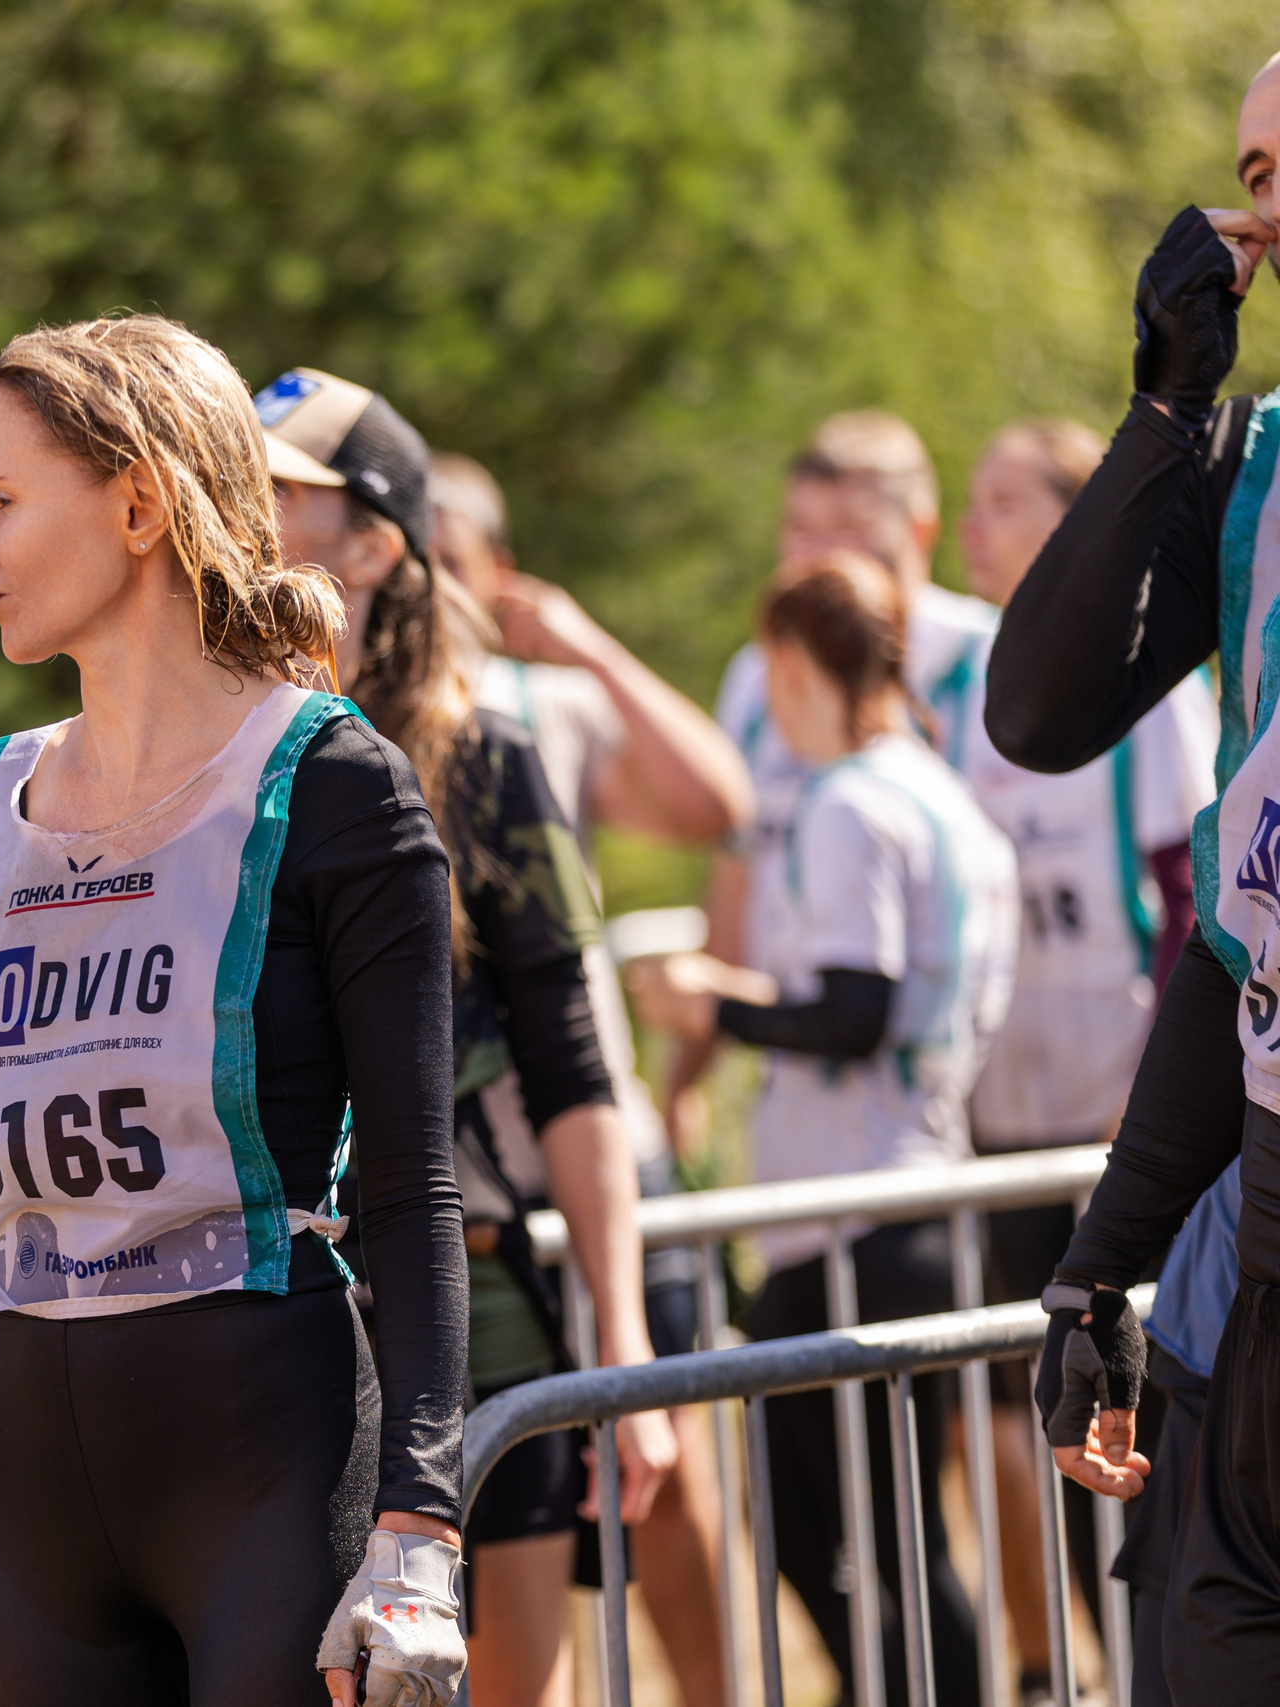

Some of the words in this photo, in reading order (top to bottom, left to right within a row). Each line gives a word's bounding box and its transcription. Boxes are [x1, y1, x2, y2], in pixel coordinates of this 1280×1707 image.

[9, 884, 64, 909] ГОНКА
[72, 872, 154, 899] ГЕРОЕВ
[64, 1038, 122, 1057] БЛАГОСОСТОЯНИЕ
[123, 1037, 140, 1049] ДЛЯ
[141, 1037, 162, 1048] ВСЕХ
